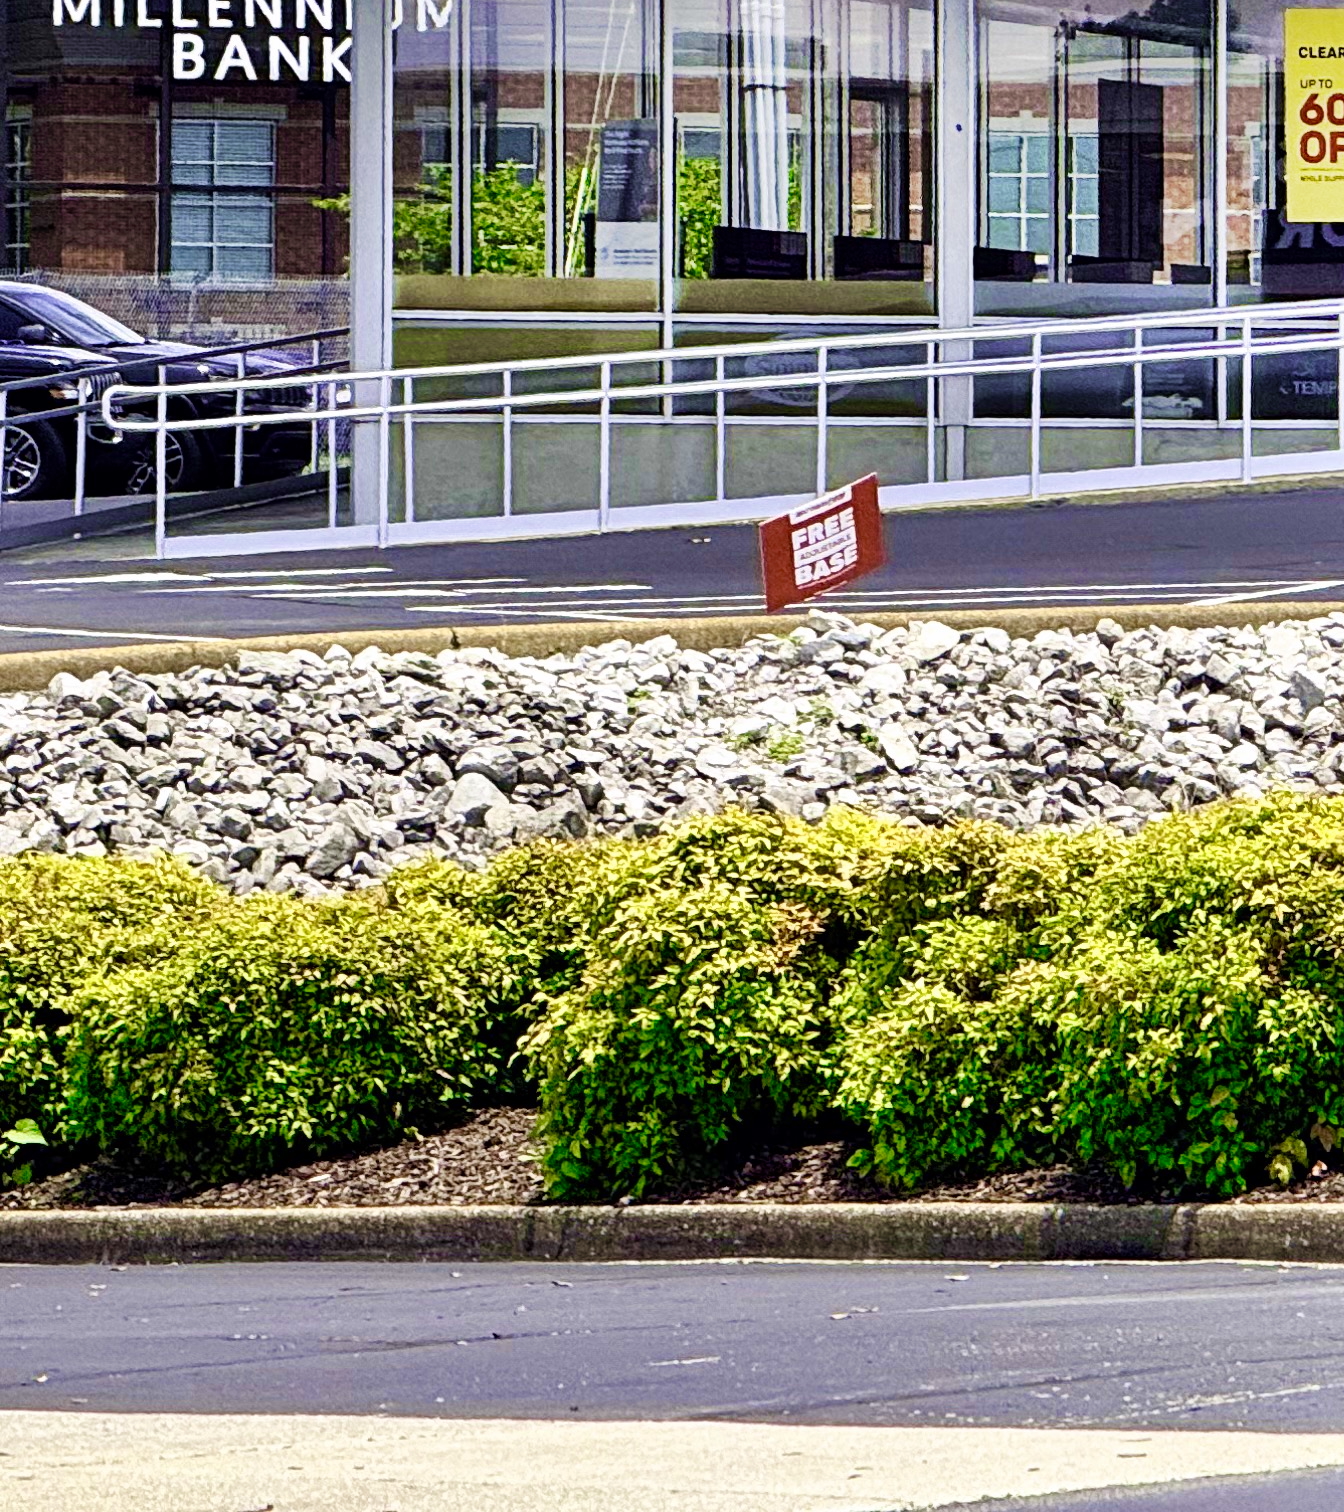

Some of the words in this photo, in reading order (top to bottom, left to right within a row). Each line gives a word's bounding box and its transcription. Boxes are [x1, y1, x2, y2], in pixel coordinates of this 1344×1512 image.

[173, 33, 353, 83] BANK
[1300, 79, 1316, 89] UP
[1318, 79, 1333, 89] TO
[791, 506, 855, 551] FREE
[795, 543, 859, 586] BASE
